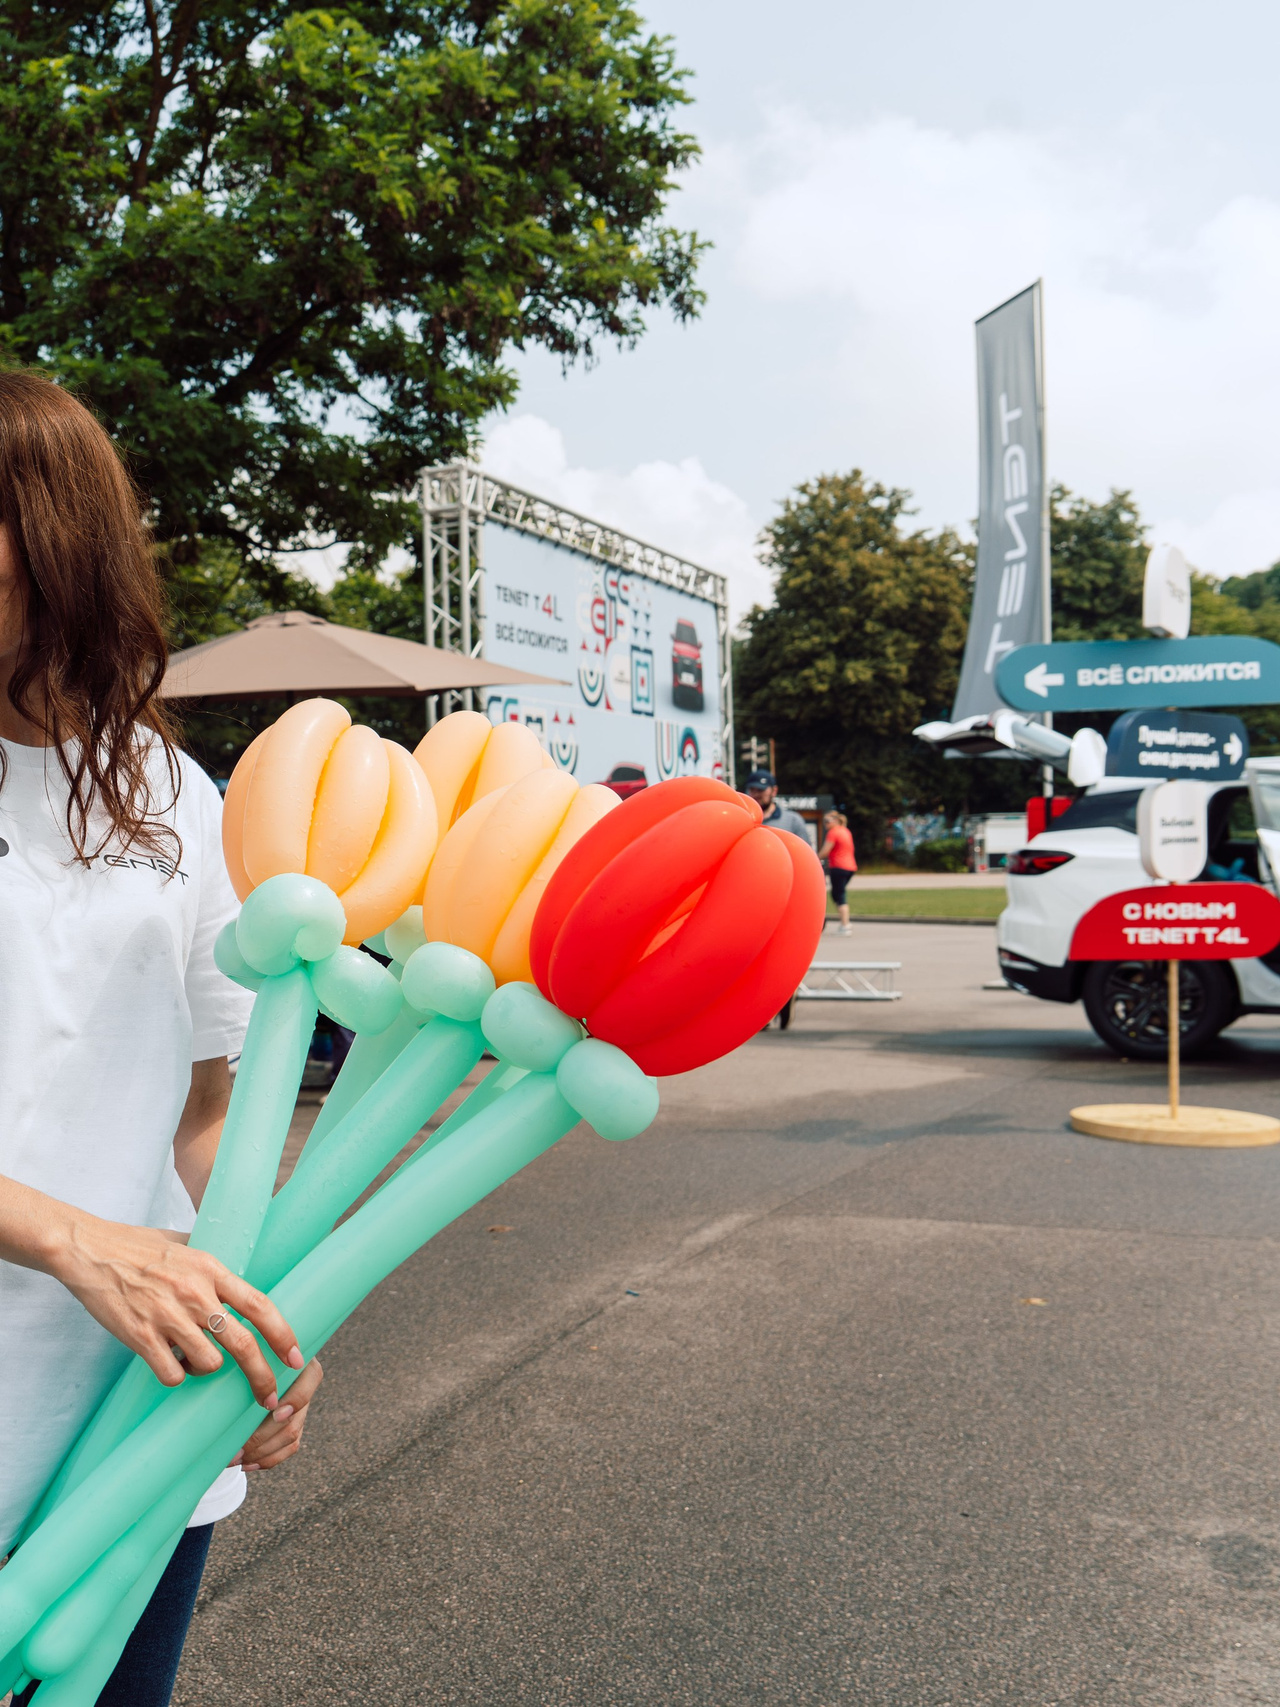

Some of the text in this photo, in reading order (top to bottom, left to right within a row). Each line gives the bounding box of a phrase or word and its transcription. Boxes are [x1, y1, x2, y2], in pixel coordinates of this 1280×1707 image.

[495, 585, 563, 622] TENET T4L
[496, 622, 568, 654] ВСЁ СЛОЖИТСЯ
[1076, 661, 1261, 686] ВСЁ СЛОЖИТСЯ
[73, 854, 189, 885] TENET
[1122, 902, 1236, 920] С НОВЫМ
[1122, 927, 1249, 944] TENET T4L
